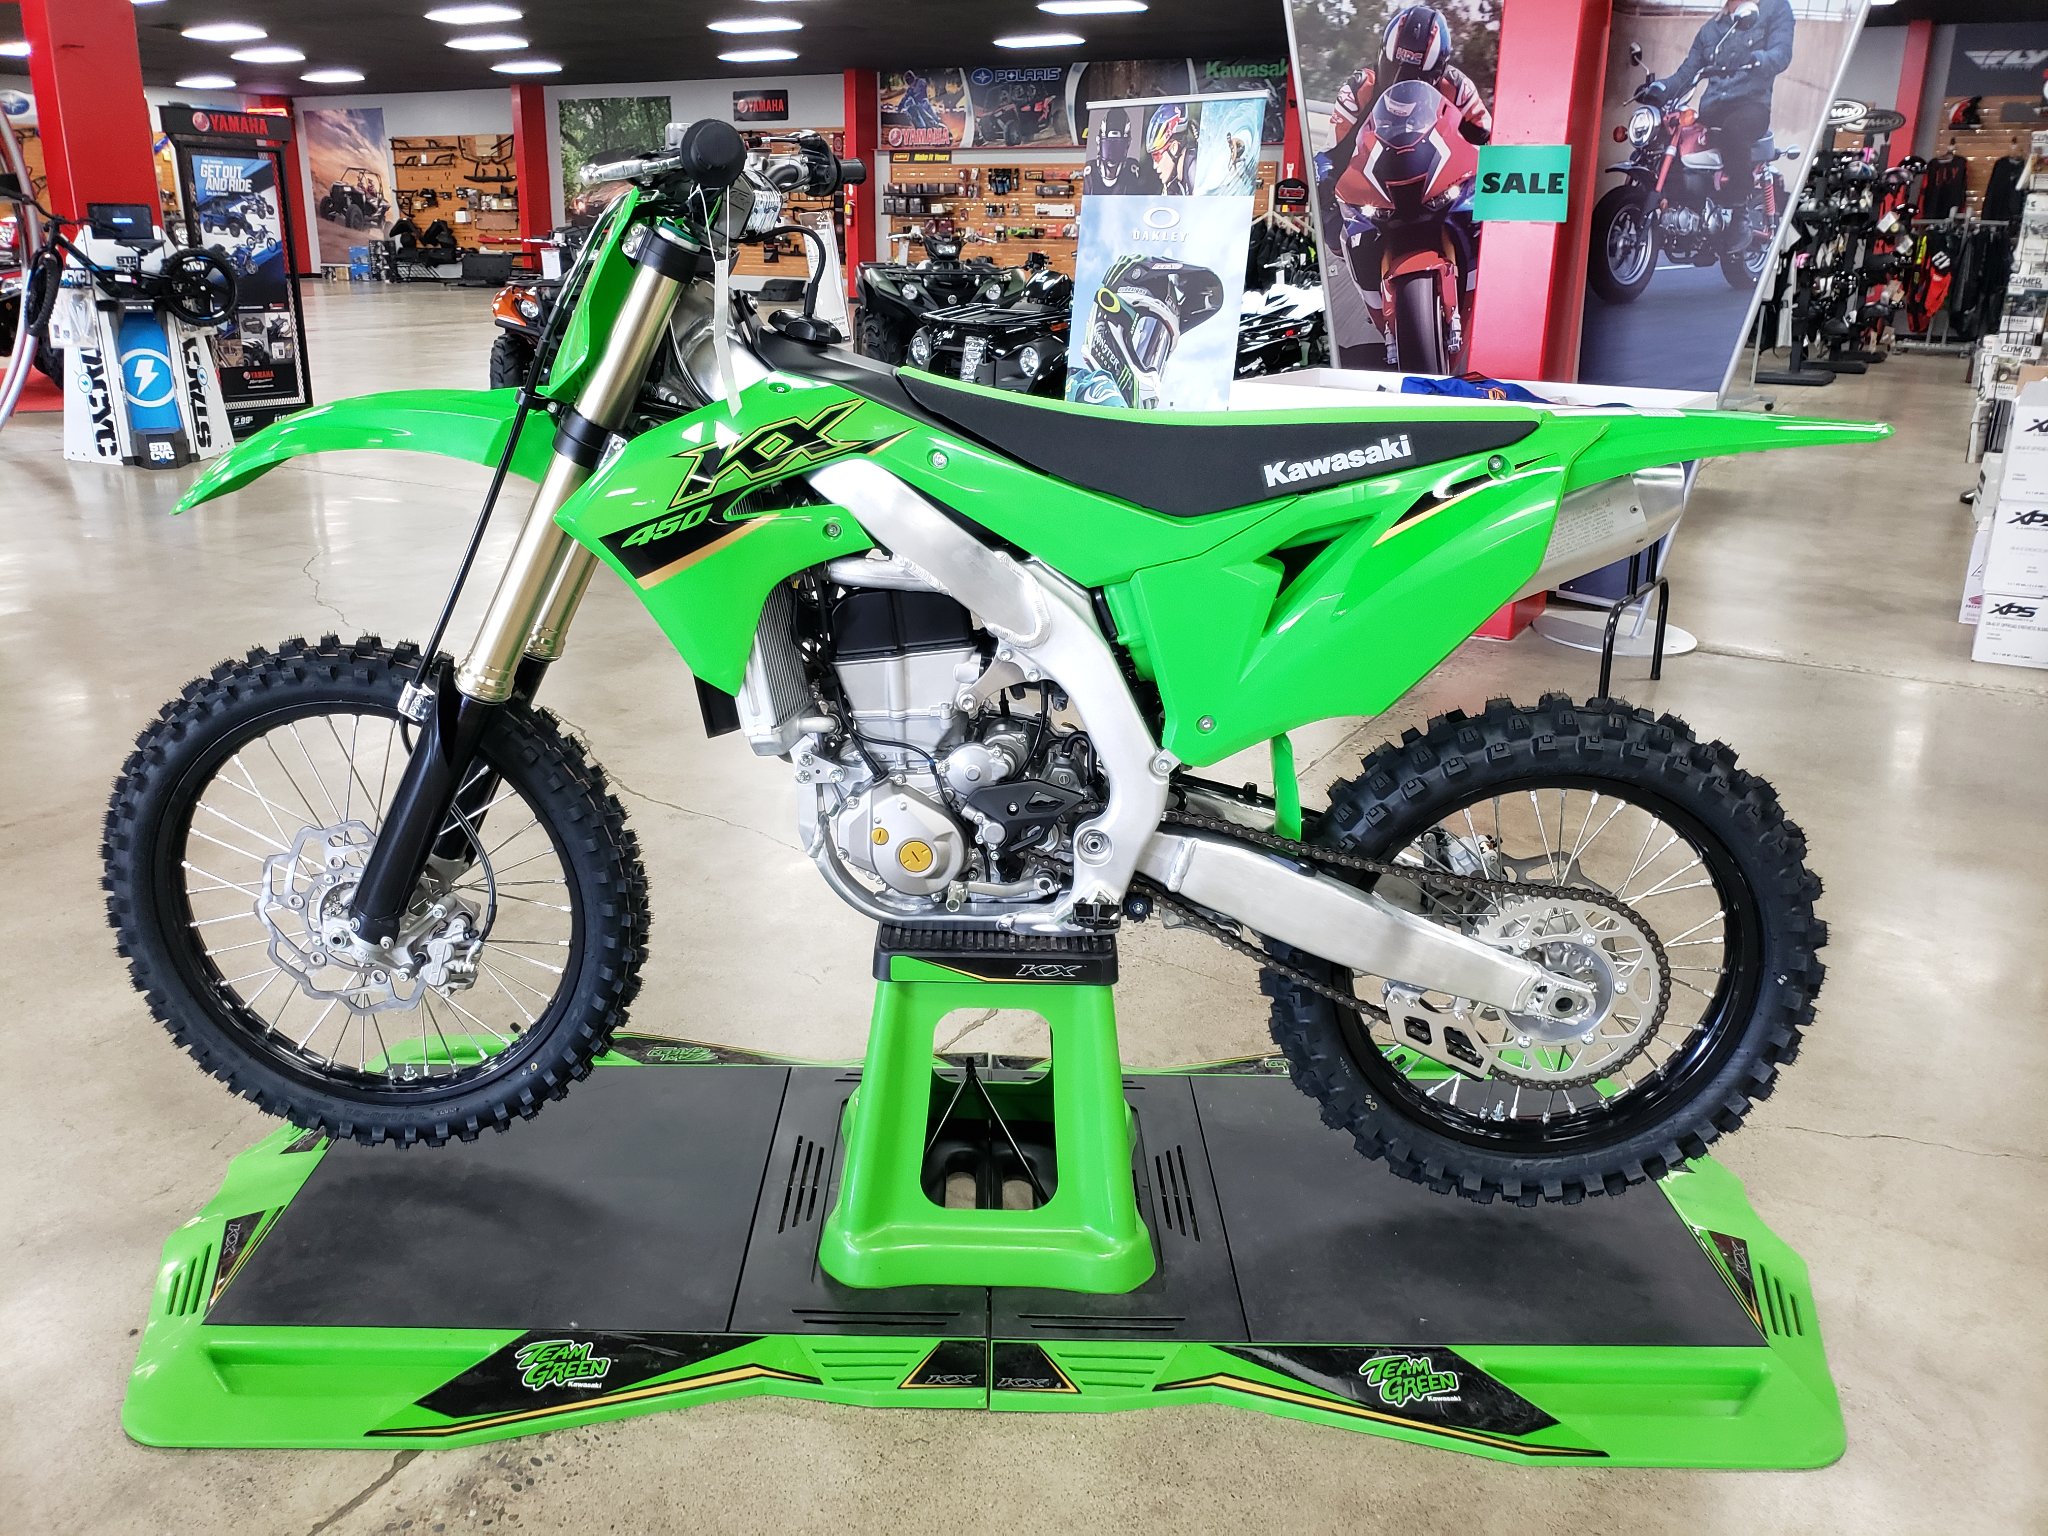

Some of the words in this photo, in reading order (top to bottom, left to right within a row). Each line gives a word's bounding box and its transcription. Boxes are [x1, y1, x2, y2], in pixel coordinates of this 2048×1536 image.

[995, 68, 1060, 82] POLARIS
[1206, 57, 1289, 79] Kawasak
[749, 98, 784, 112] YAMAHA
[210, 113, 268, 135] YAMAHA
[901, 127, 950, 145] YAMAHA
[200, 164, 221, 178] GET
[222, 165, 243, 179] OUT
[205, 176, 228, 191] AND
[229, 178, 252, 192] RIDE
[1481, 172, 1565, 194] SALE
[1132, 229, 1189, 243] OAKLEY
[250, 370, 275, 379] YAMAHA
[149, 442, 172, 452] STA
[666, 397, 870, 510] KX
[150, 451, 175, 461] CYC
[1264, 434, 1412, 488] Kawasaki
[621, 503, 714, 549] 450
[1988, 603, 2039, 618] XPS
[1015, 963, 1083, 977] KX
[222, 1223, 242, 1256] KX
[515, 1340, 594, 1370] TEAM
[522, 1358, 611, 1391] GREEN
[1359, 1355, 1432, 1386] TEAM
[567, 1381, 602, 1389] Kawasaki
[925, 1374, 977, 1384] KX
[997, 1377, 1050, 1388] KX
[1379, 1371, 1460, 1407] GREEN
